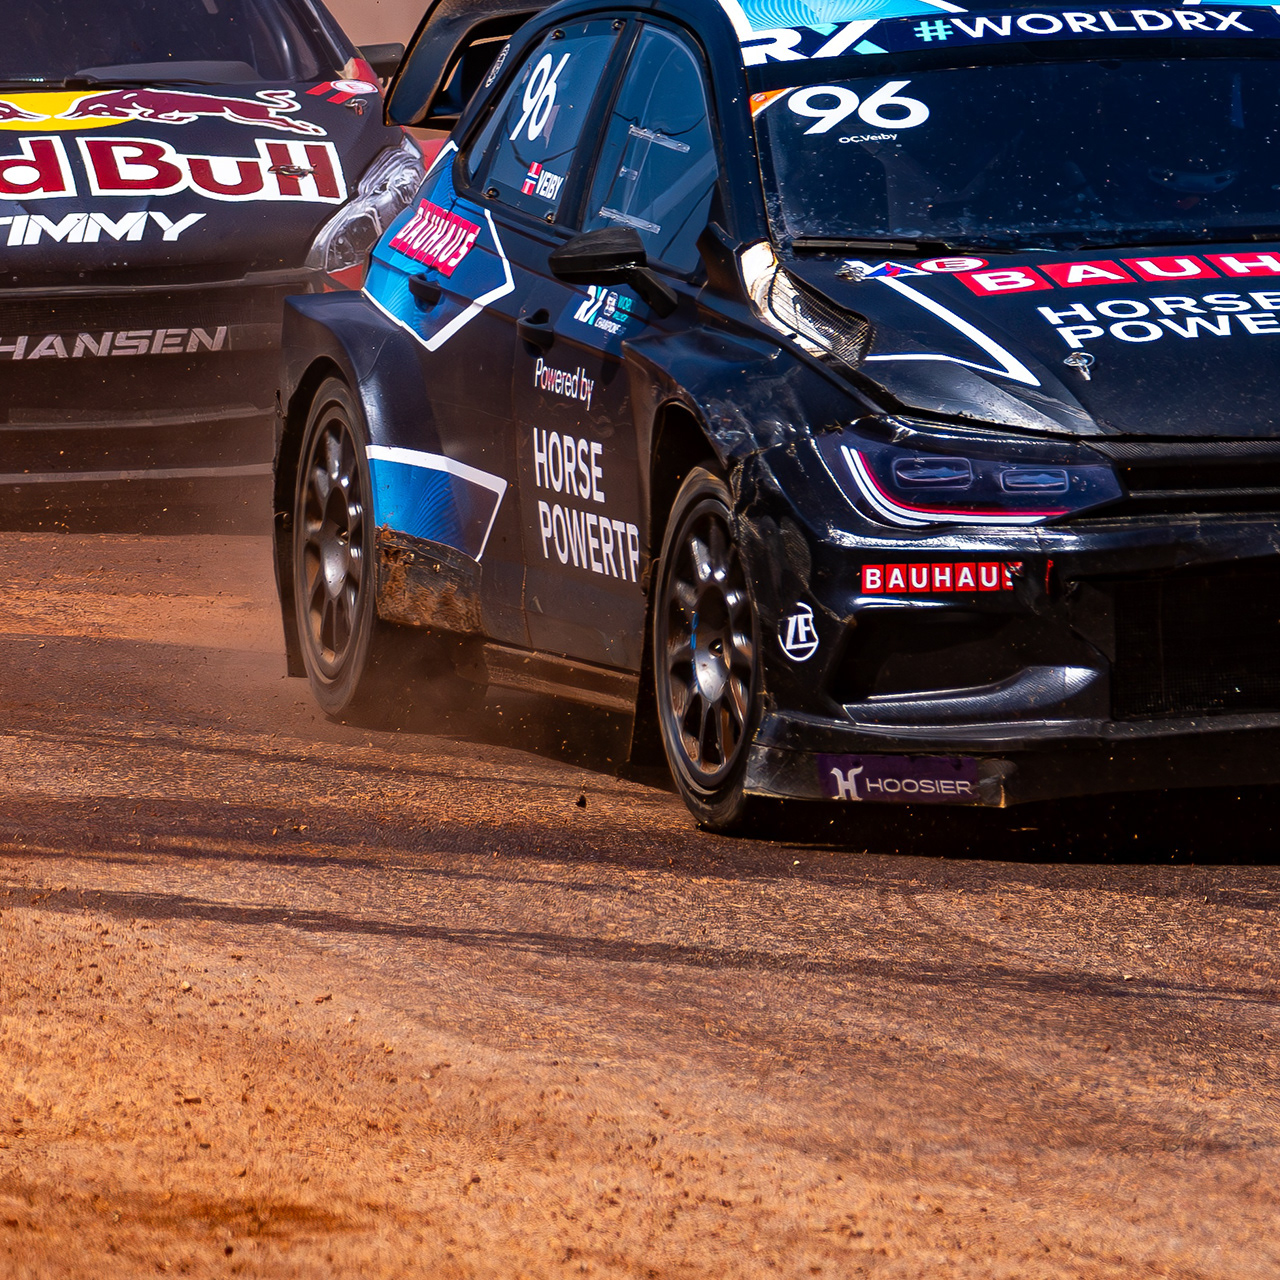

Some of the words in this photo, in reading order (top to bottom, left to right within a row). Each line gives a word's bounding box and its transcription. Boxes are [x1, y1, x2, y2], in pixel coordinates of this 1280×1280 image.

[740, 19, 889, 67] RX
[913, 10, 1254, 43] #WORLDRX
[509, 53, 571, 141] 96
[787, 80, 930, 136] 96
[79, 138, 346, 202] Bull
[535, 169, 564, 200] VEIBY
[396, 206, 478, 268] BAUHAUS
[534, 357, 581, 400] Powered
[580, 368, 595, 411] by
[533, 426, 605, 503] HORSE
[865, 777, 973, 795] HOOSIER
